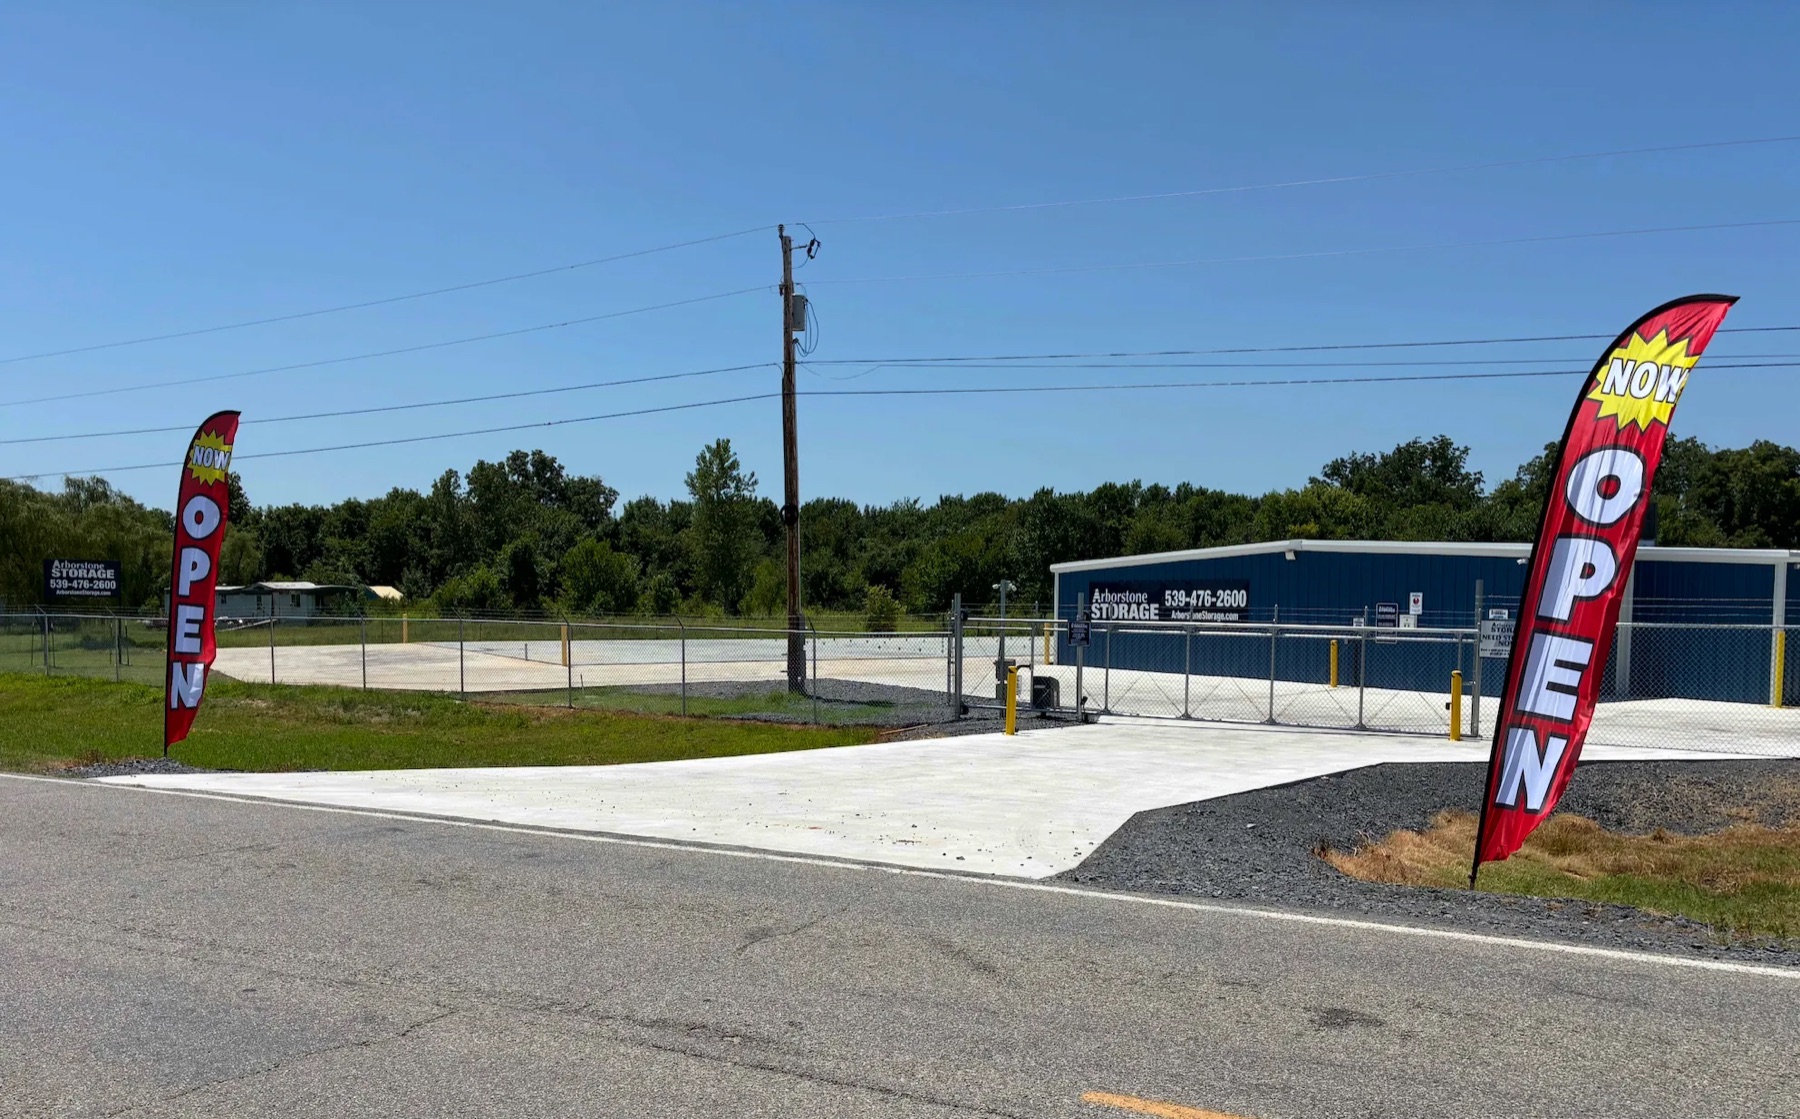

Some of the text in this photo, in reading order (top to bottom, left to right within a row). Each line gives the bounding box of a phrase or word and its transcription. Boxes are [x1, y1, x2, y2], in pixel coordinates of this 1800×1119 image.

[1600, 357, 1689, 404] NOW
[192, 445, 230, 471] NOW
[51, 568, 115, 579] STORAGE
[52, 559, 105, 570] Arborstone
[49, 579, 117, 590] 539-476-2600
[170, 495, 222, 710] OPEN
[1092, 588, 1148, 604] Arborstone
[1164, 589, 1248, 608] 539-476-2600
[1090, 602, 1160, 620] STORAGE
[1495, 444, 1647, 814] OPEN
